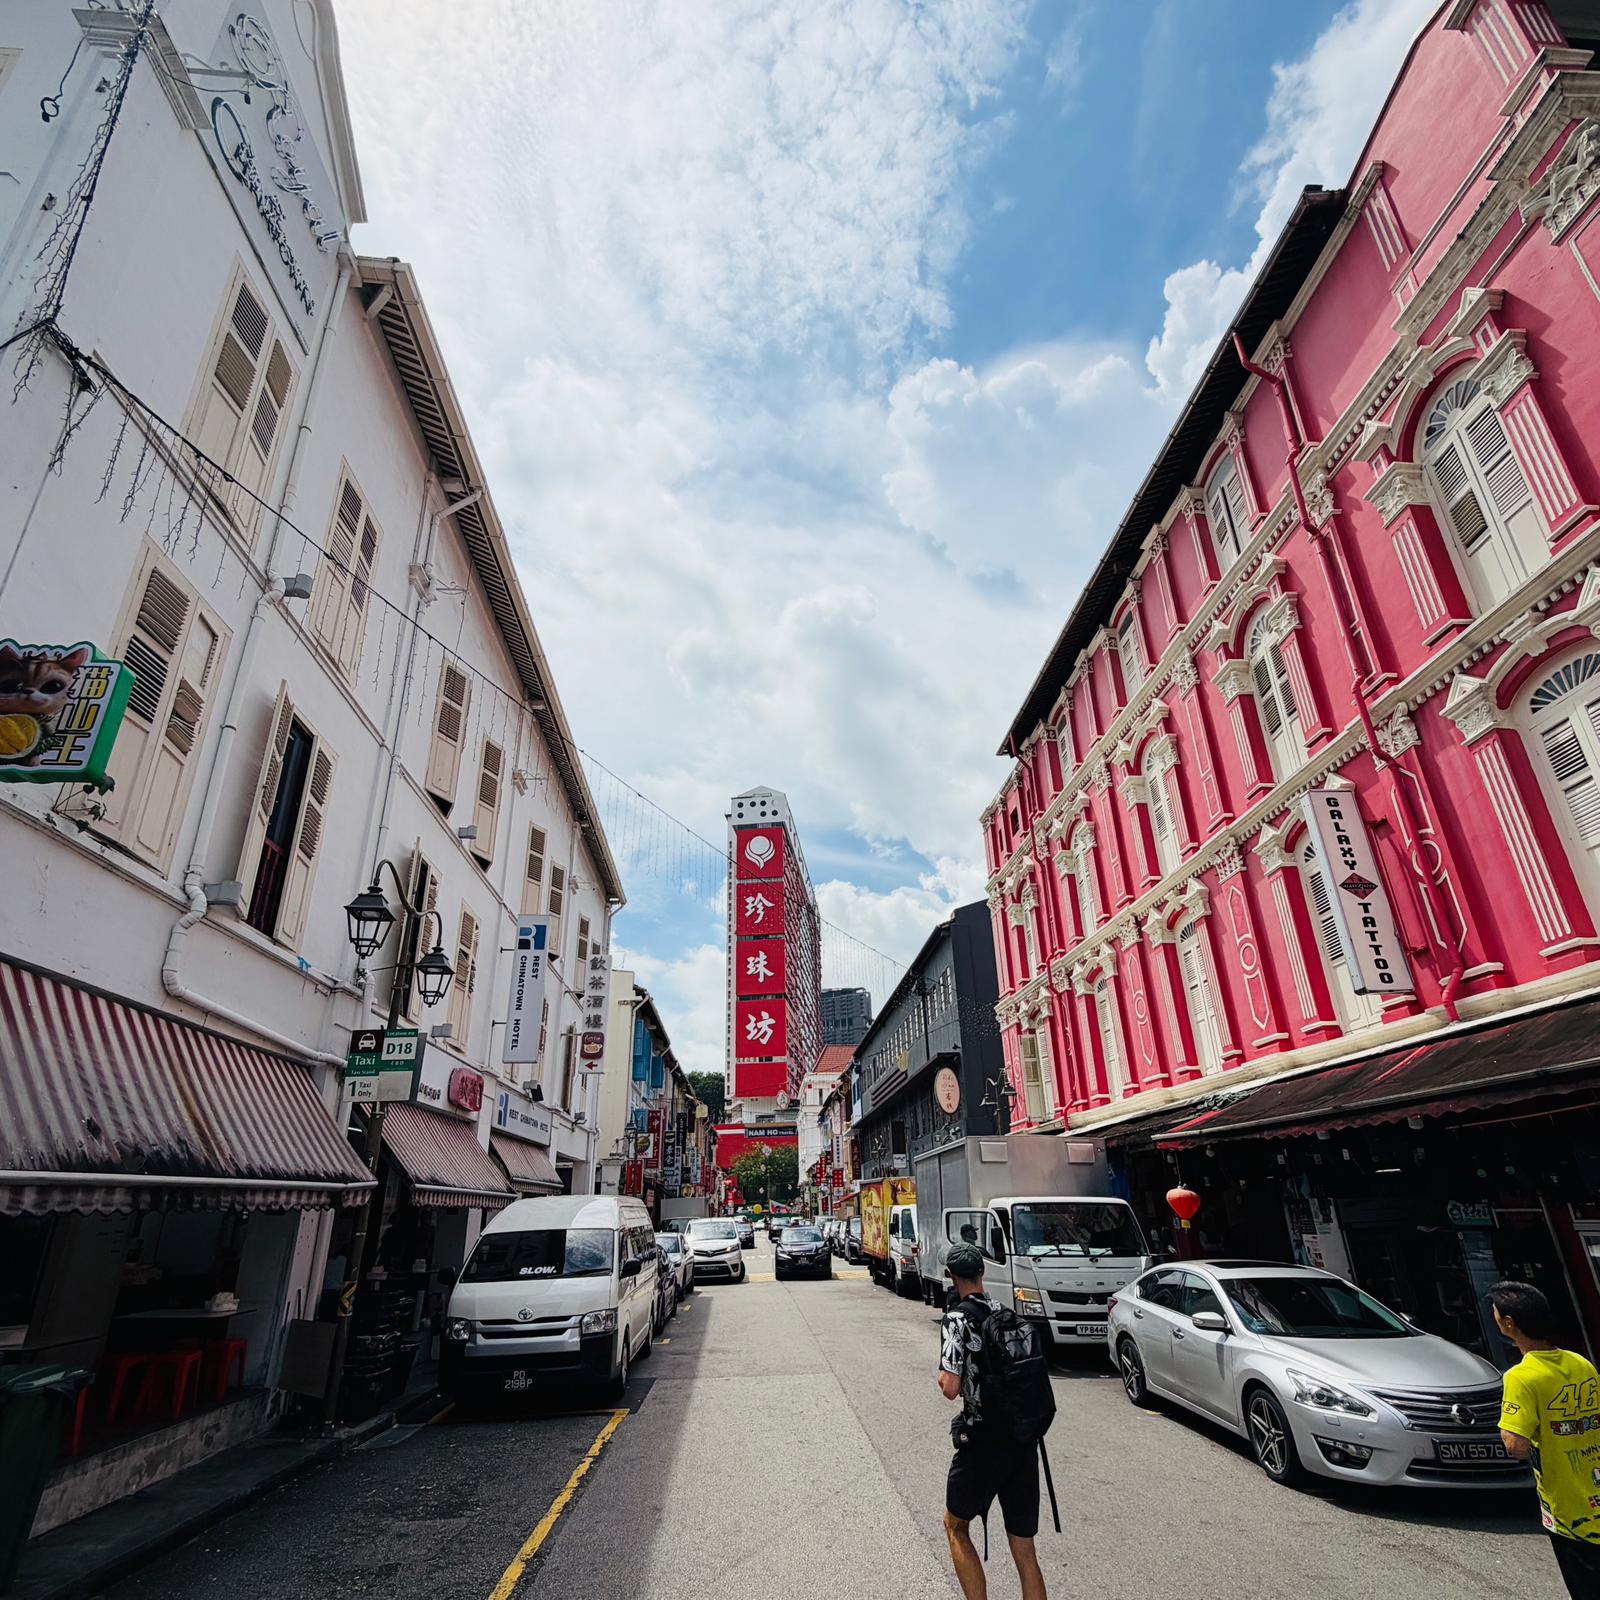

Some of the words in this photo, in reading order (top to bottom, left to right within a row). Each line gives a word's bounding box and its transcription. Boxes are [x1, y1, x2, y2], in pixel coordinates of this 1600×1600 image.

[40, 666, 112, 766] 猫山王
[1326, 797, 1358, 871] GALAXY
[1358, 902, 1394, 985] TATTOO
[531, 955, 540, 980] REST
[745, 892, 776, 1045] 珍珠坊
[515, 955, 528, 1011] CHINATOWN
[386, 1042, 413, 1055] D18
[510, 1018, 521, 1051] HOTEL
[355, 1055, 376, 1066] Taxi
[348, 1080, 357, 1097] 1
[358, 1090, 372, 1098] Only
[509, 1108, 519, 1121] REST
[520, 1113, 539, 1128] CHINATOWN
[519, 1265, 557, 1275] SLOW.
[1547, 1377, 1600, 1417] 46
